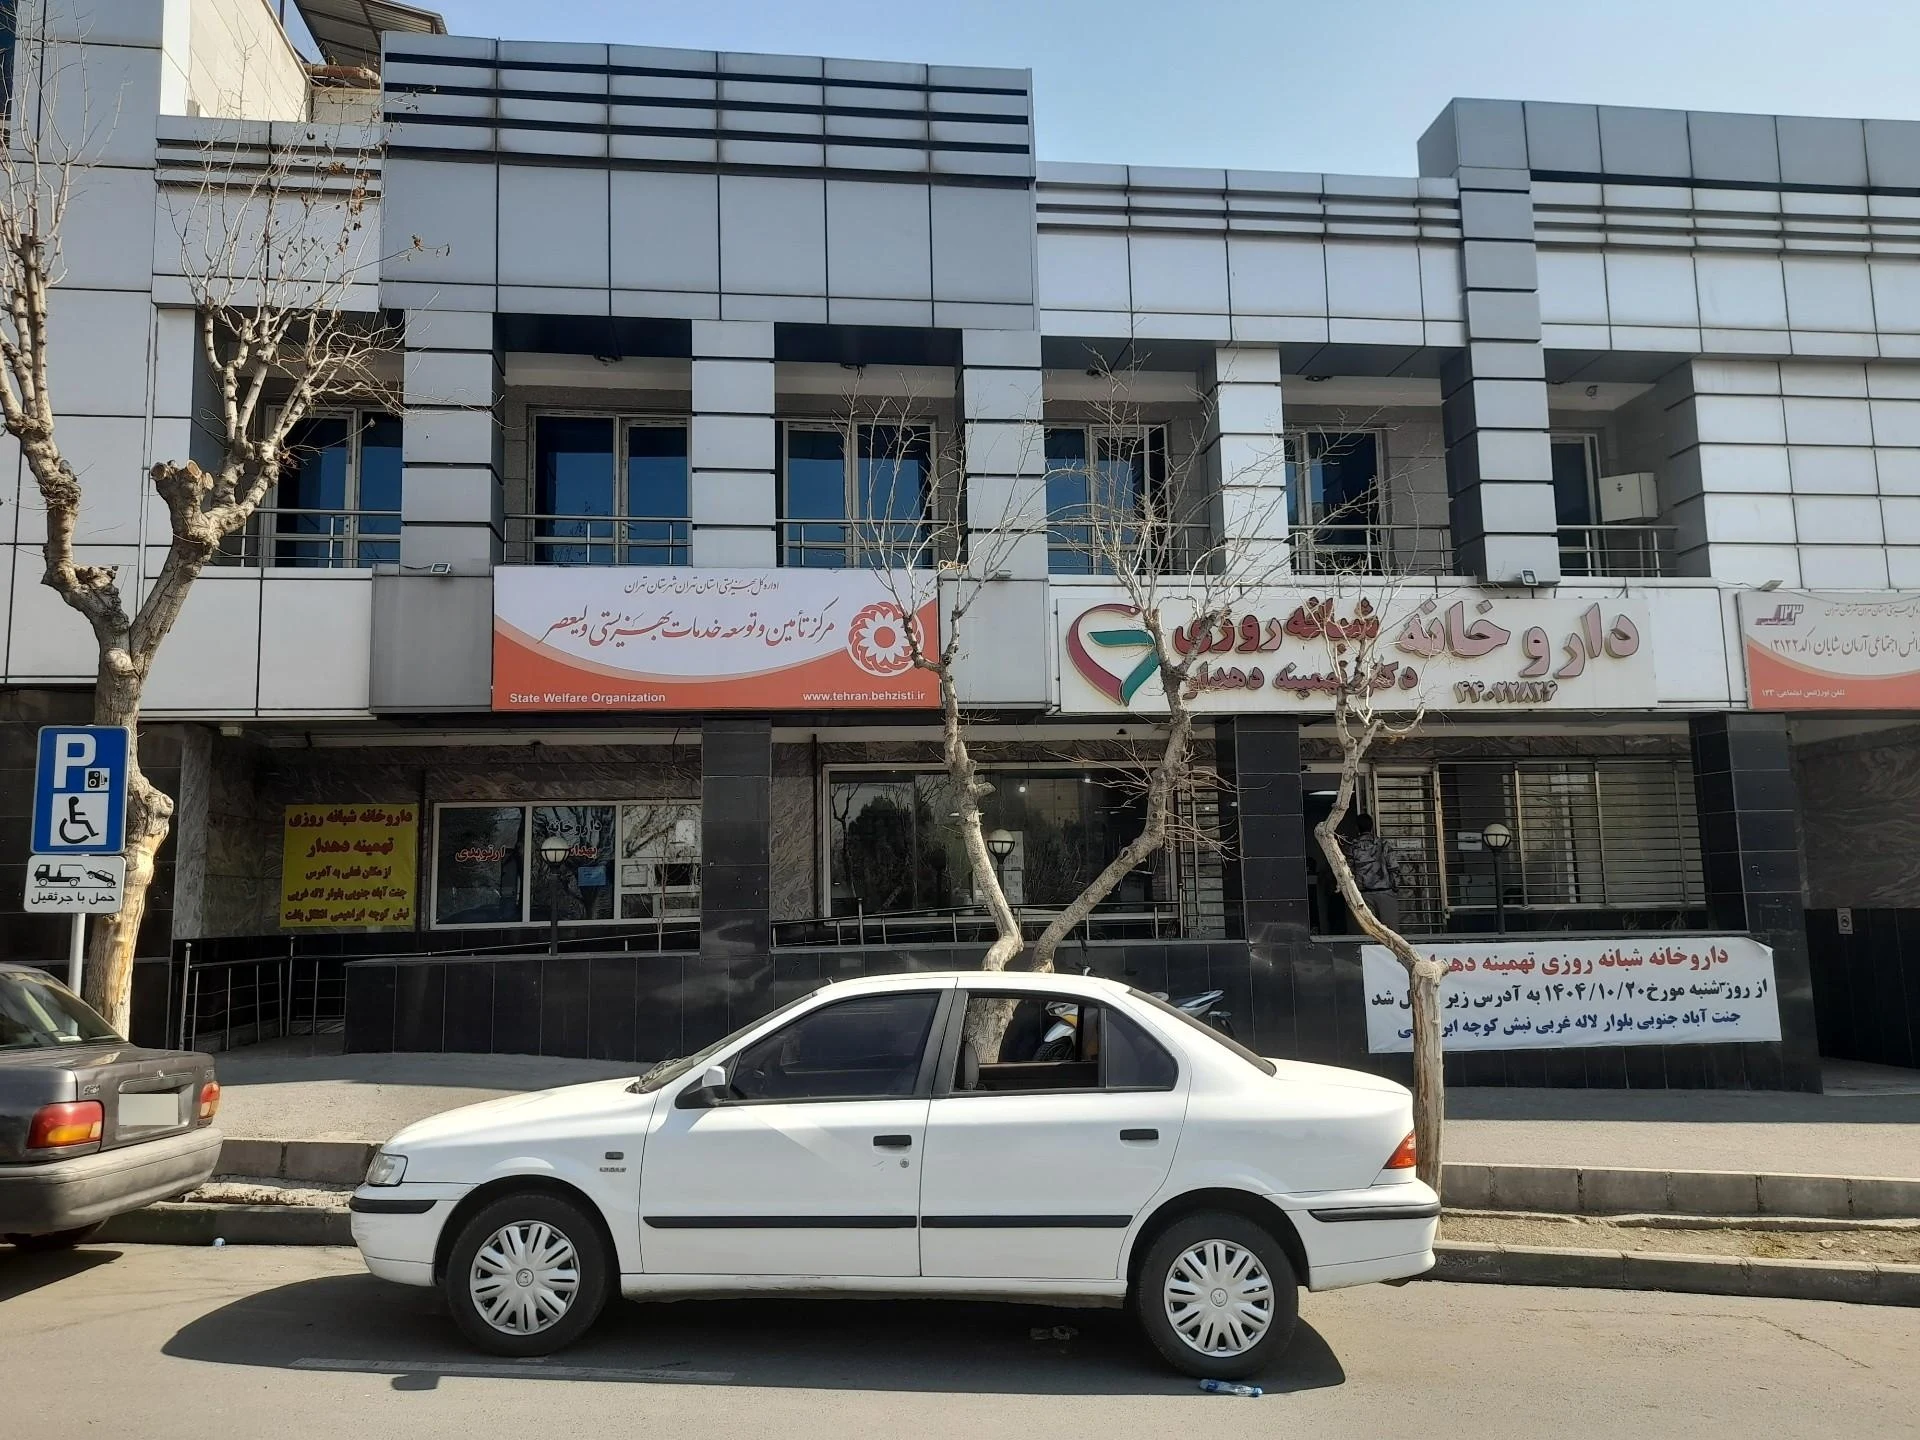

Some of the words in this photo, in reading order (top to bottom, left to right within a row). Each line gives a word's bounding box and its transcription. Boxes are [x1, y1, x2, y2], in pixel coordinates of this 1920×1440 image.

[624, 576, 648, 593] تهران
[647, 575, 677, 594] شهرستان
[675, 576, 698, 594] تهران
[696, 579, 718, 594] استان
[662, 616, 722, 638] خدمات
[721, 612, 757, 638] توسعه
[766, 610, 809, 646] تأمین
[808, 596, 839, 643] مرکز
[1284, 596, 1380, 656] شبانه
[589, 611, 673, 647] بهزیستی
[756, 623, 765, 638] و
[1173, 604, 1283, 656] روزی
[1868, 634, 1898, 658] اجتماعی
[510, 693, 540, 703] State
[544, 692, 588, 703] Welfare
[591, 692, 666, 704] Organization
[803, 691, 925, 701] www.tehran.behzisti.ir
[54, 733, 96, 789] P
[288, 811, 324, 827] روزی
[326, 808, 357, 826] شبانه
[359, 808, 413, 827] داروخانه
[546, 819, 602, 837] داروخانه
[305, 836, 350, 858] دهدار
[353, 837, 394, 856] تهمینه
[305, 865, 332, 880] آدرس
[31, 891, 73, 905] جرثقیل
[77, 891, 85, 902] با
[89, 892, 116, 905] حمل
[326, 888, 344, 900] بلوار
[345, 888, 370, 900] جنوبی
[372, 886, 388, 900] آباد
[389, 888, 407, 900] جنت
[368, 907, 390, 921] کوچه
[392, 907, 409, 920] نبش
[1482, 952, 1535, 975] تهمینه
[1541, 954, 1593, 975] روزی
[1598, 947, 1643, 971] شبانه
[1649, 945, 1729, 971] داروخانه
[1473, 984, 1522, 1008] آدرس
[1646, 982, 1685, 1001] مورخ
[1755, 978, 1768, 998] از
[1371, 990, 1395, 1006] شد
[1444, 991, 1469, 1009] زیر
[1526, 989, 1541, 1006] به
[1503, 1016, 1532, 1035] نبش
[1535, 1016, 1571, 1036] غربی
[1575, 1013, 1598, 1029] لاله
[1603, 1012, 1633, 1032] بلوار
[1637, 1015, 1678, 1030] جنوبی
[1682, 1008, 1708, 1027] آباد
[1711, 1011, 1741, 1026] جنت
[1462, 1017, 1499, 1037] کوچه
